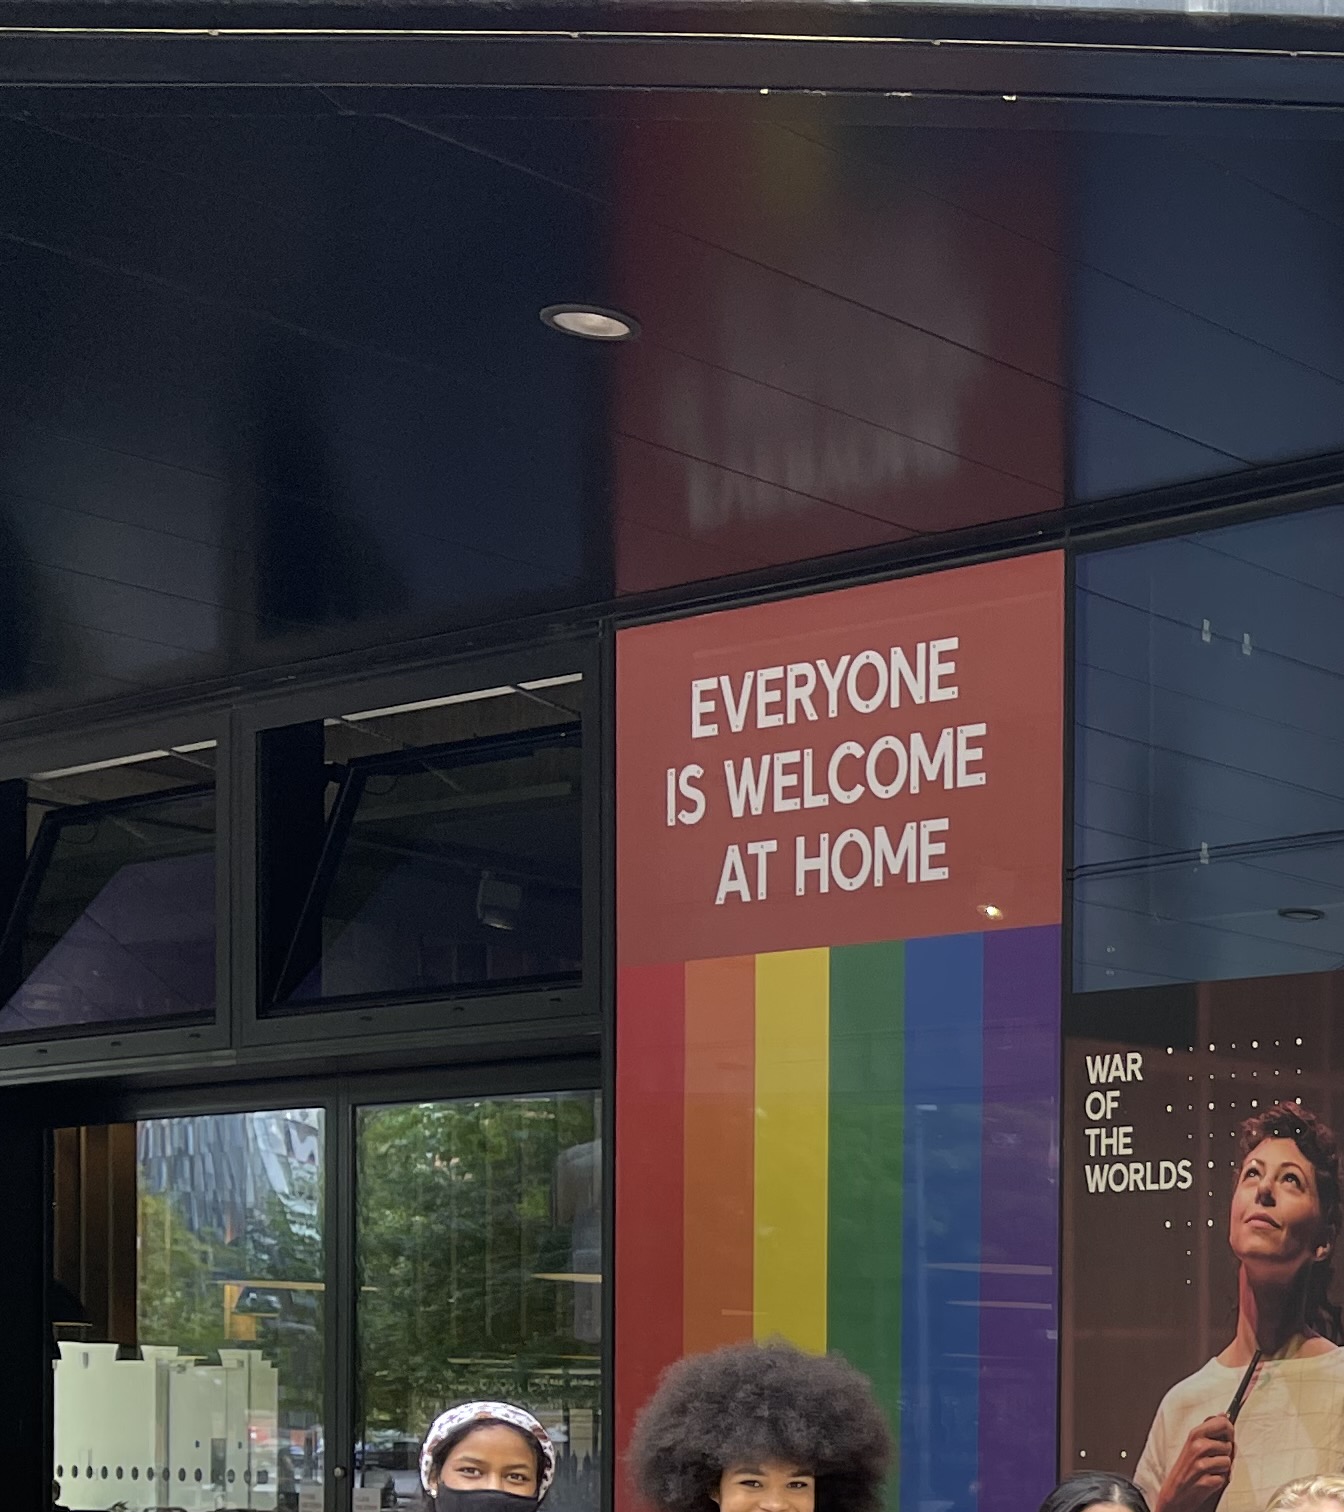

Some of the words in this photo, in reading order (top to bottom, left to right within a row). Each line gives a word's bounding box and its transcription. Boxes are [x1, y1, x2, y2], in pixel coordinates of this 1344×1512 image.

[692, 636, 959, 738] EVERYONE
[666, 764, 705, 826] IS
[724, 723, 987, 818] WELCOME
[715, 840, 777, 905] AT
[795, 818, 949, 896] HOME
[1086, 1052, 1143, 1084] WAR
[1085, 1090, 1120, 1121] OF
[1085, 1126, 1133, 1157] THE
[1085, 1159, 1192, 1193] WORLDS
